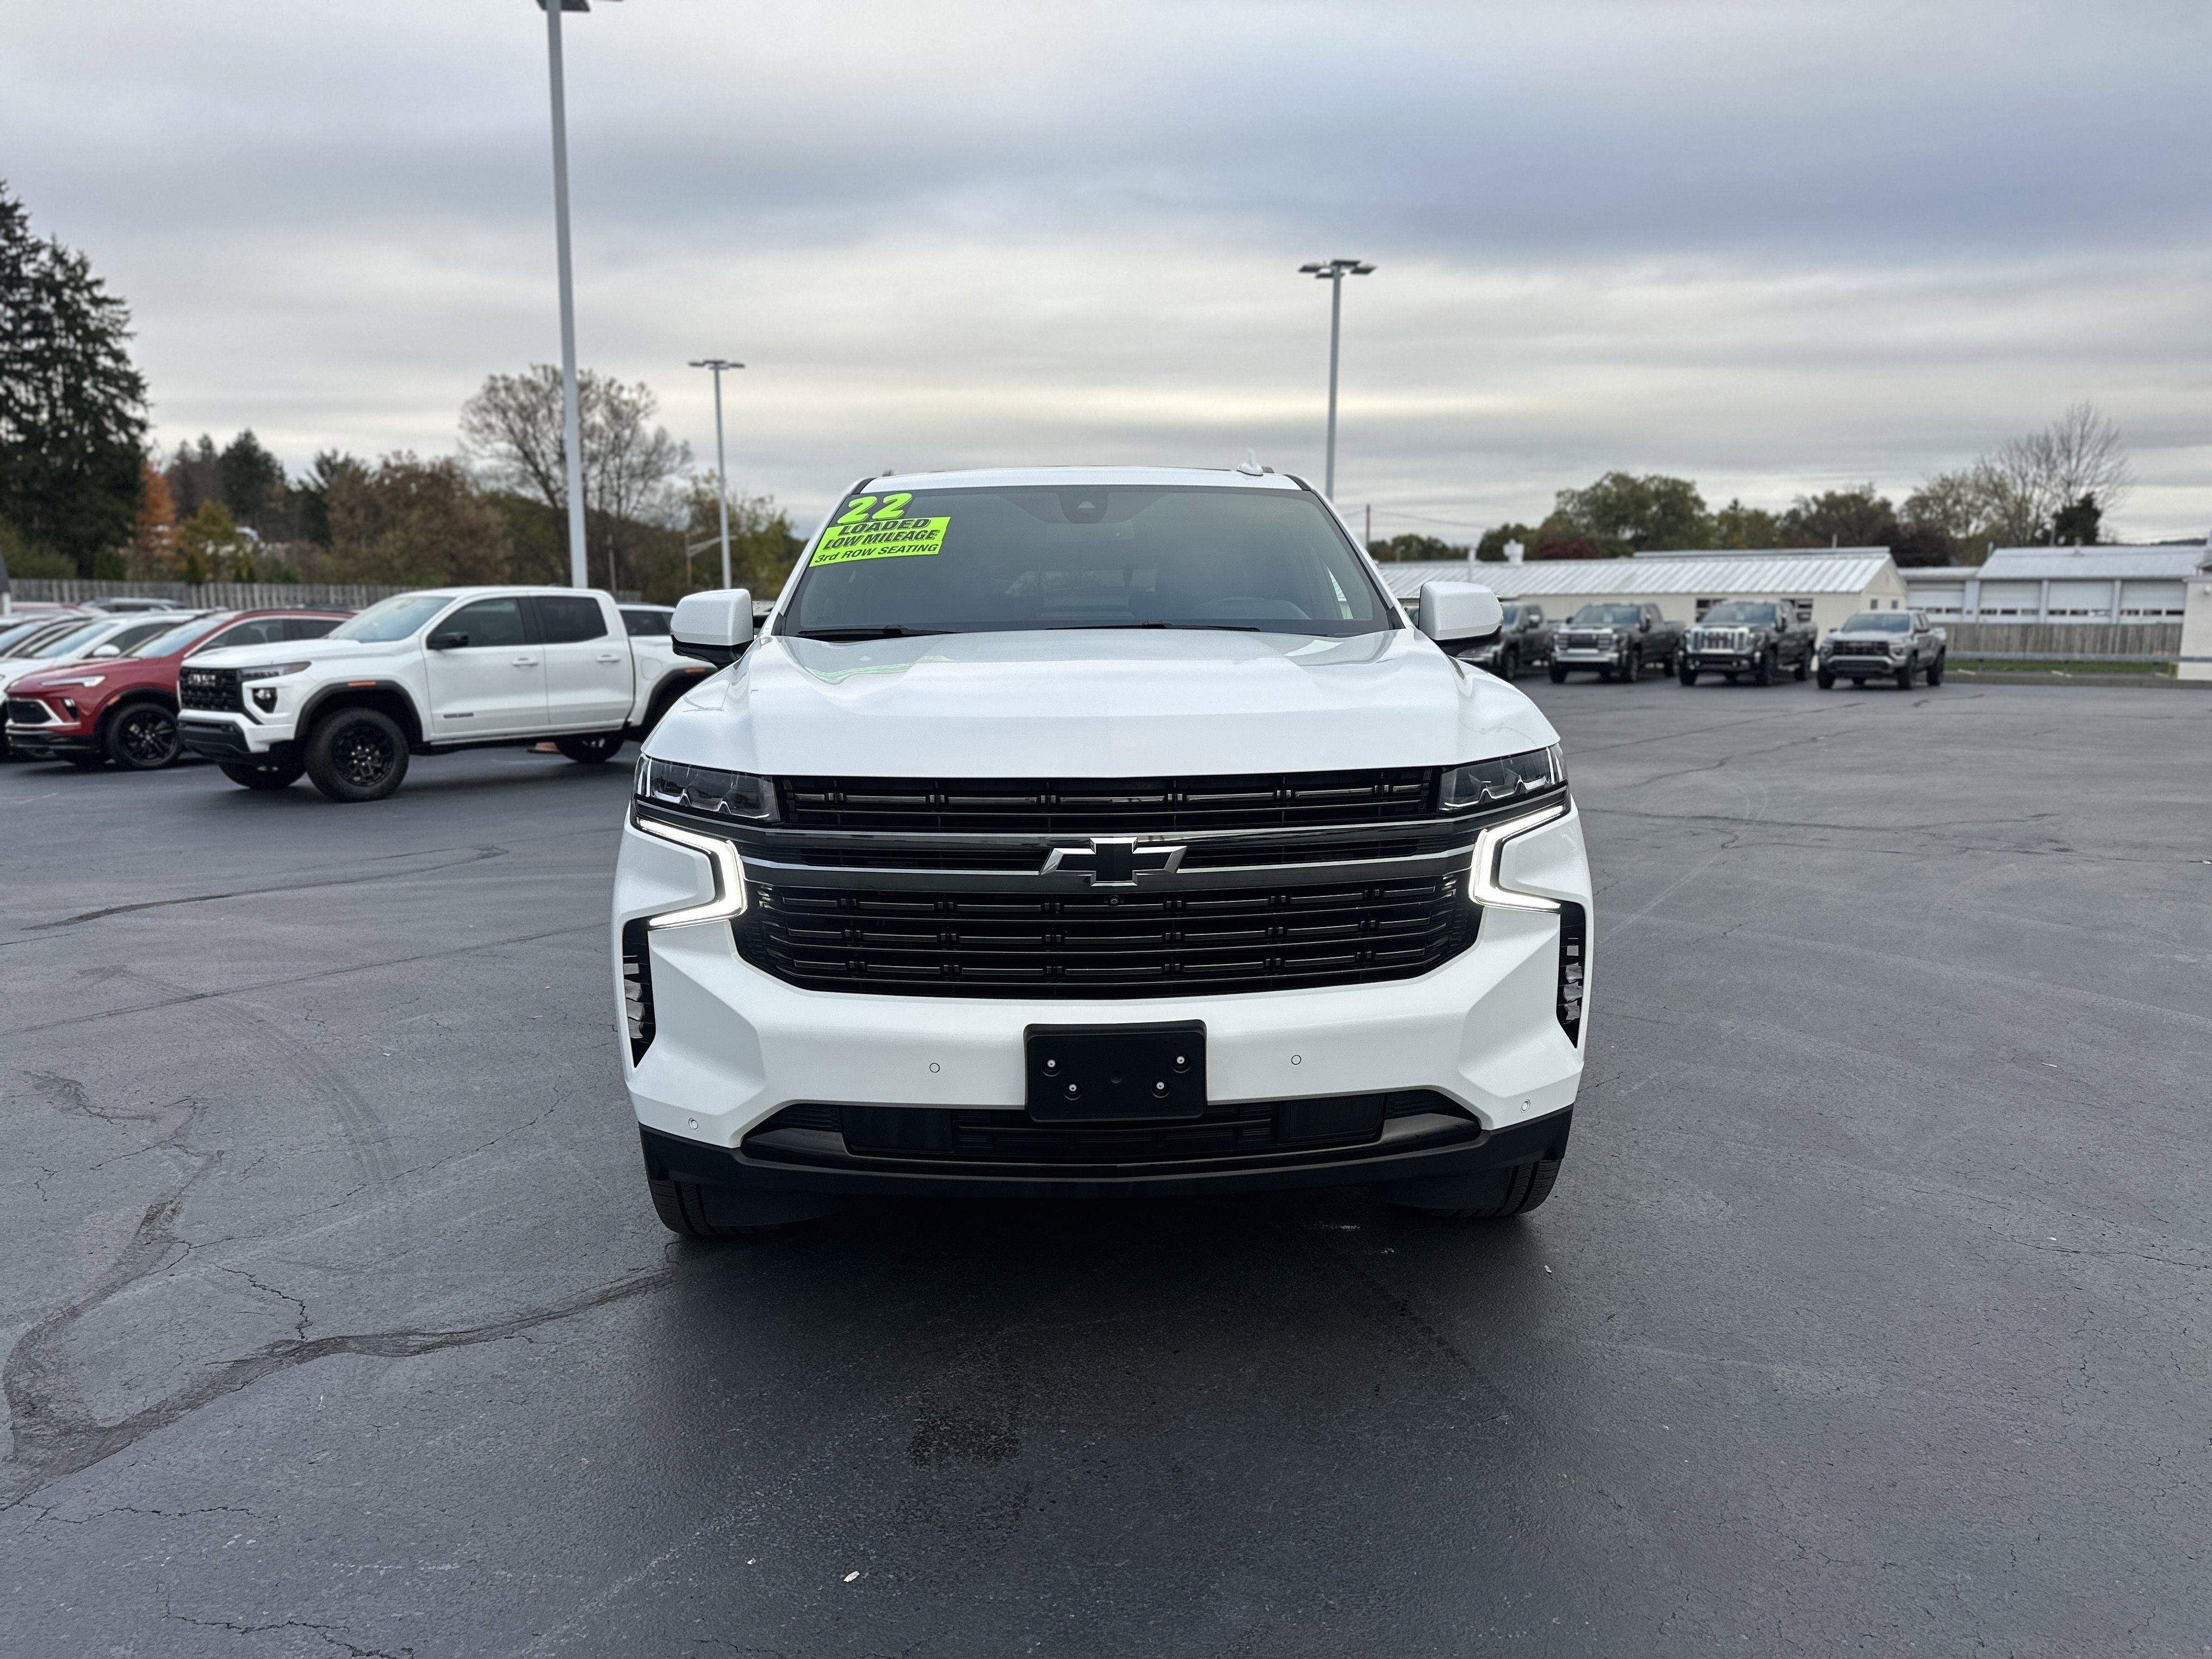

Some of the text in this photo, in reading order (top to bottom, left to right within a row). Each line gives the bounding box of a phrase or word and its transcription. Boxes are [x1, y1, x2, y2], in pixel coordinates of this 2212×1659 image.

[837, 493, 912, 524] 22
[838, 518, 932, 537] LOADED
[823, 529, 940, 551] LOW MILEAGE
[815, 544, 939, 563] 3rd ROW SEATING
